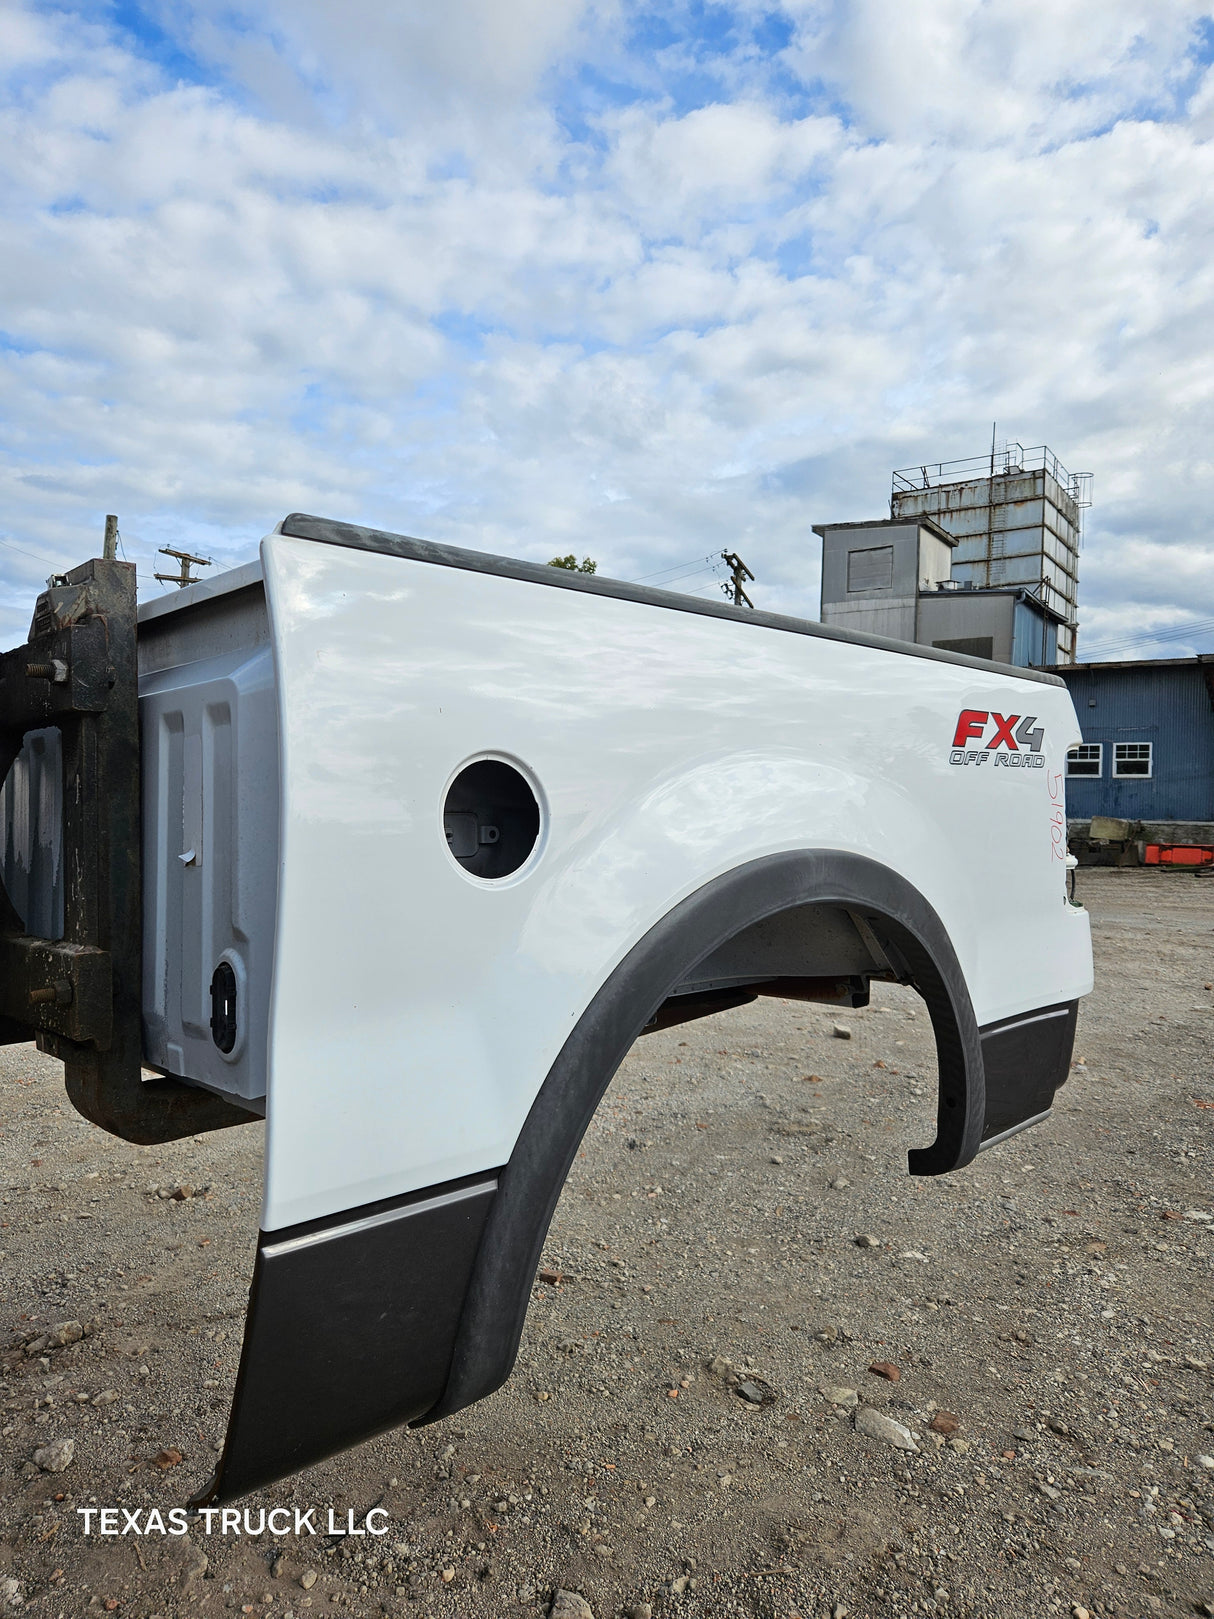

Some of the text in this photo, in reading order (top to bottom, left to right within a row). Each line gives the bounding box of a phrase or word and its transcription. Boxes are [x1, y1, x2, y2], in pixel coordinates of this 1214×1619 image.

[952, 709, 1045, 752] FX4
[949, 750, 1046, 768] OFF ROAD
[1047, 769, 1064, 862] 51902
